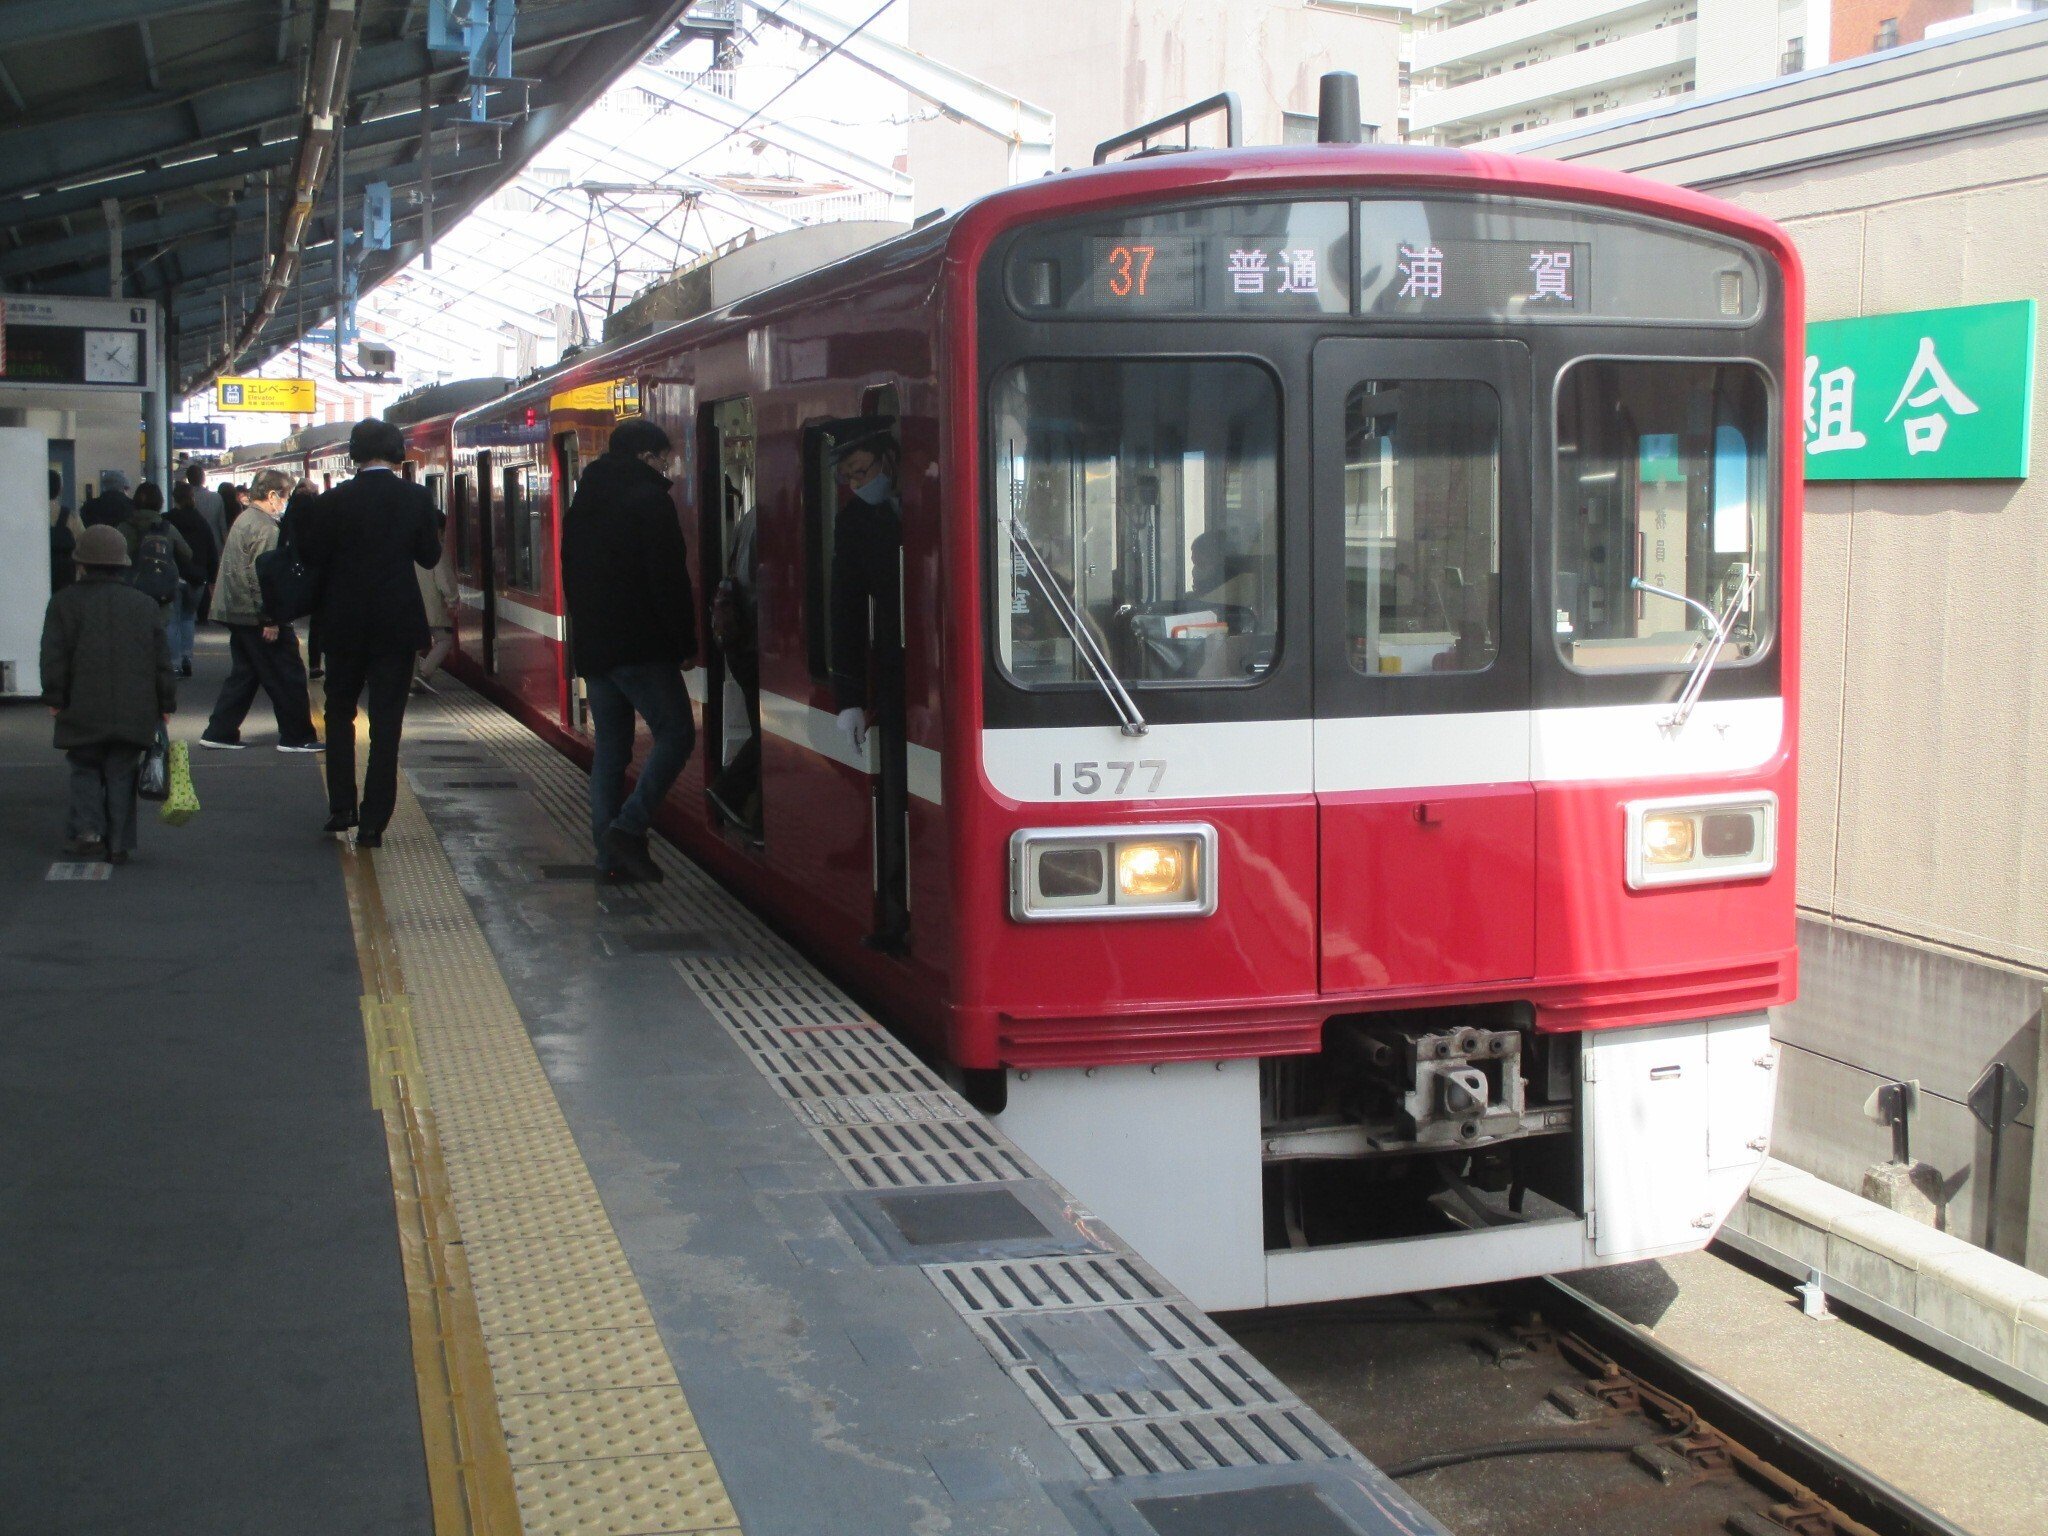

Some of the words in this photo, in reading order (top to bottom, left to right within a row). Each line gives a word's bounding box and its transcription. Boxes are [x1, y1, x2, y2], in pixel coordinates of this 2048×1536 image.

[1109, 246, 1154, 296] 37
[1228, 248, 1319, 294] 普通
[248, 385, 310, 394] エレベーター
[1803, 337, 1979, 456] 組合
[212, 429, 219, 444] 1
[1053, 759, 1168, 797] 1577
